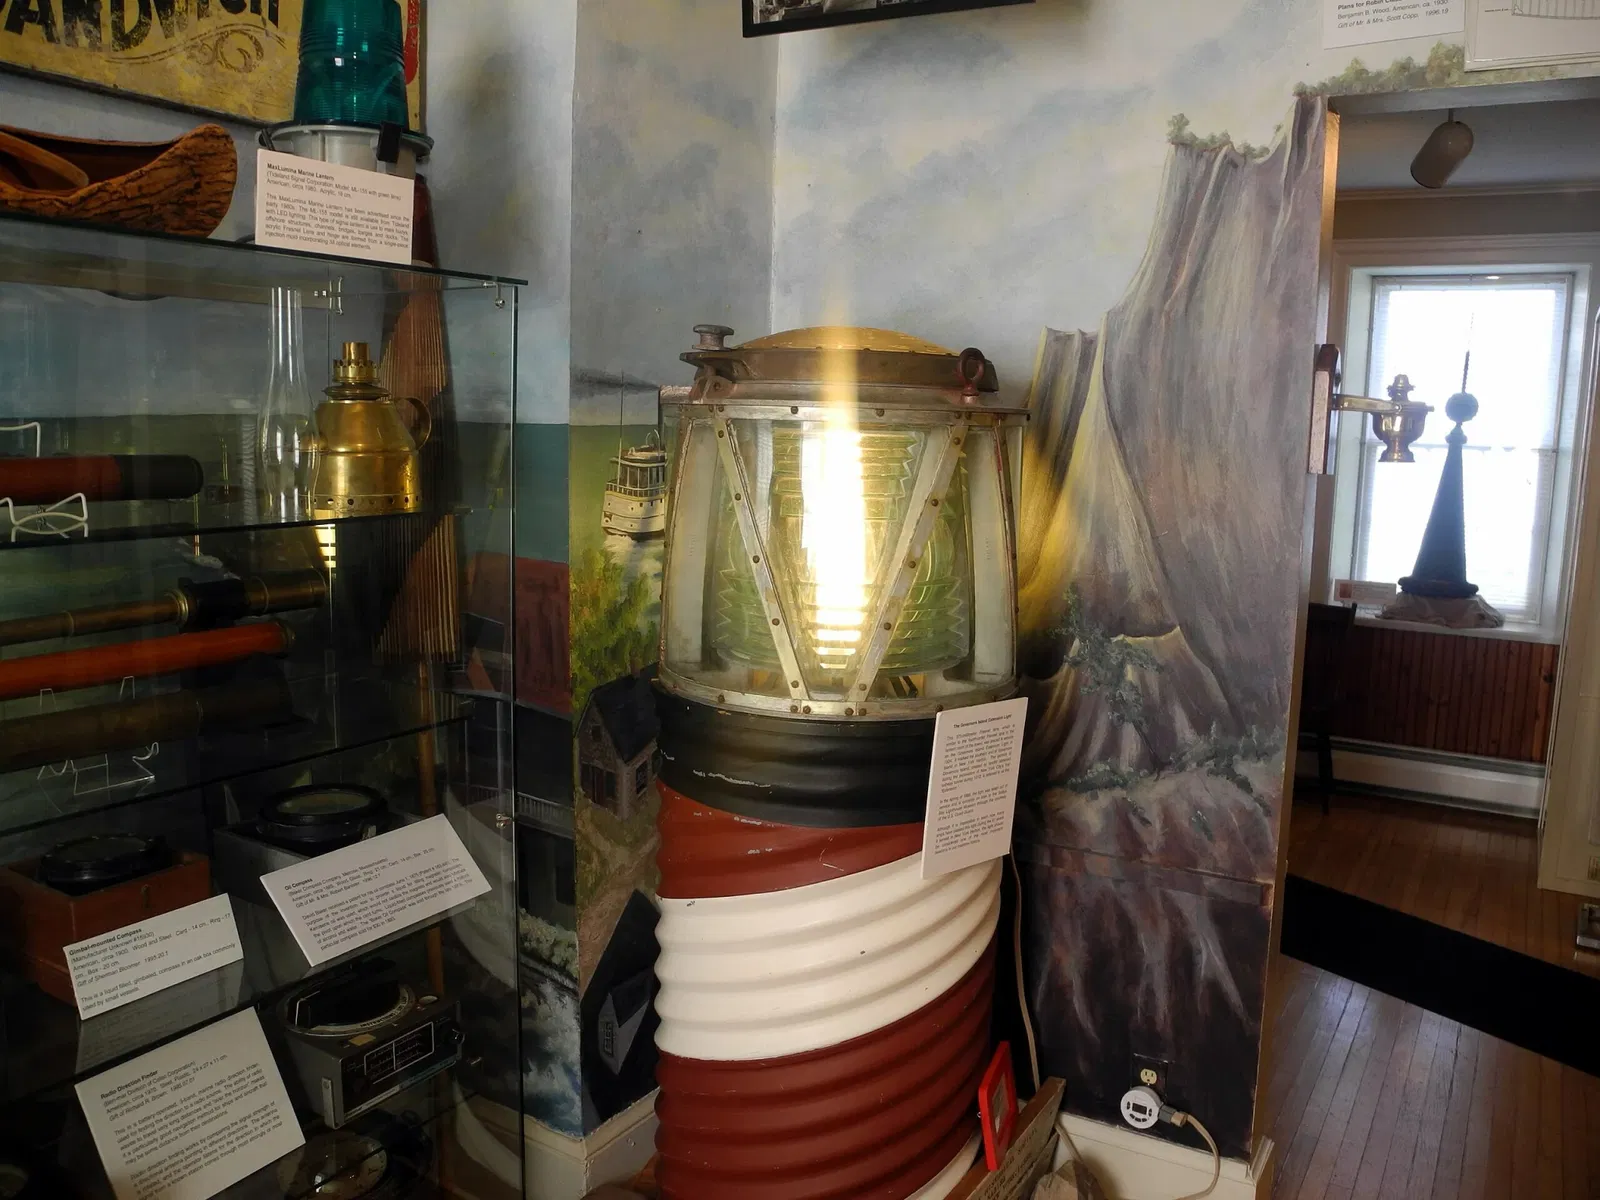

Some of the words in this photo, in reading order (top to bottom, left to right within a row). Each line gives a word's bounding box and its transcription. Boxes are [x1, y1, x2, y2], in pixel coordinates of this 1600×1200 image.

[267, 163, 296, 173] MaxLumina
[278, 195, 306, 204] MaxLumina
[291, 878, 312, 887] Compass
[69, 936, 115, 955] Gimbal-mounted
[116, 928, 141, 939] Compass
[108, 939, 132, 950] Unknown
[132, 941, 147, 950] Wood
[103, 985, 118, 994] liquid
[158, 963, 180, 974] compass
[212, 942, 235, 954] commonly
[94, 969, 118, 980] Sherman
[82, 1002, 96, 1011] used
[104, 993, 118, 1002] small
[100, 1089, 116, 1098] Radio
[117, 1078, 140, 1091] Direction
[141, 1070, 157, 1080] Finder
